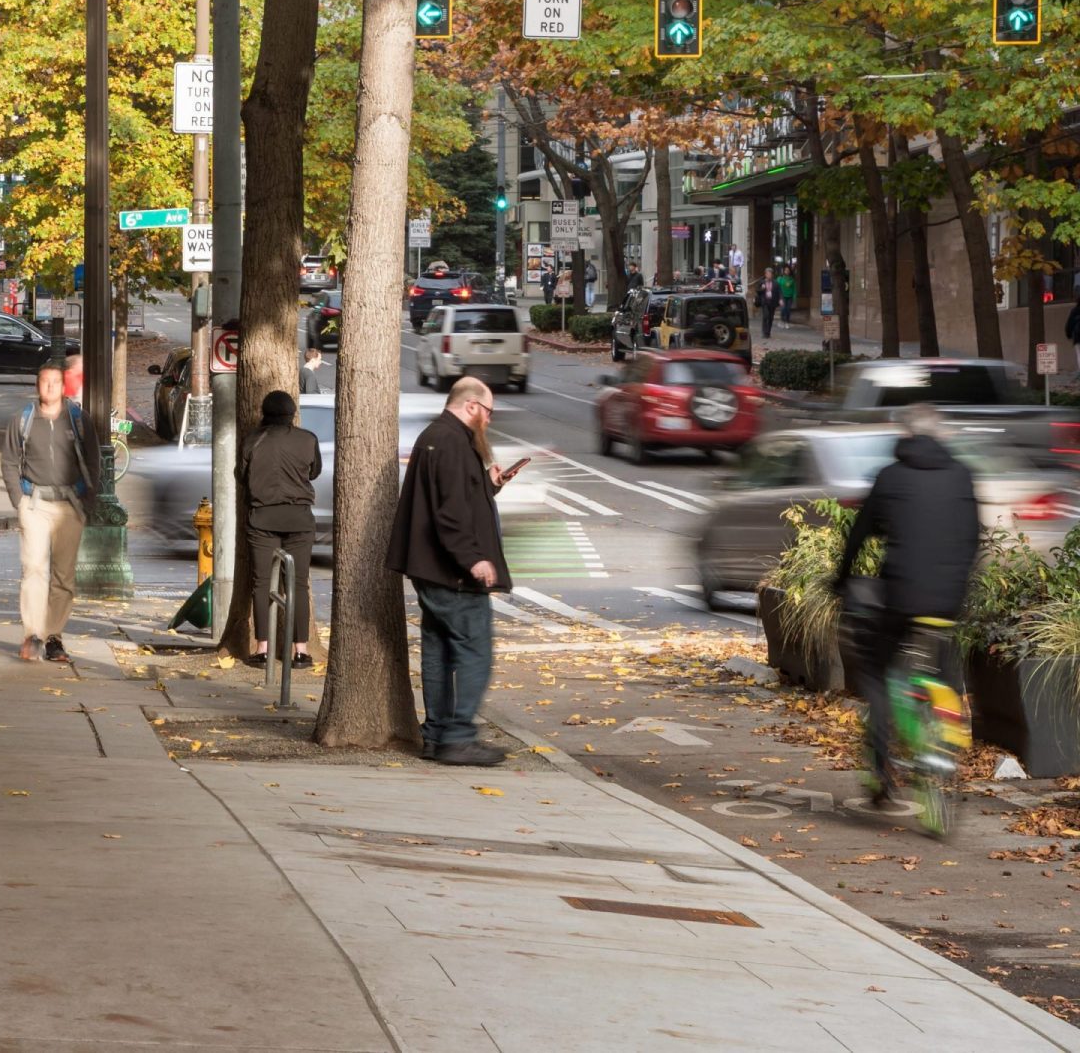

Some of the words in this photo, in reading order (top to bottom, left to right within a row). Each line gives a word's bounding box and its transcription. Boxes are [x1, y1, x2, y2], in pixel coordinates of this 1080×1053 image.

[544, 7, 561, 18] ON
[540, 22, 565, 33] RED
[191, 70, 213, 83] NO
[187, 87, 212, 97] TUR
[194, 101, 211, 112] ON
[191, 116, 213, 127] RED
[552, 218, 577, 226] BUSES
[187, 228, 213, 240] ONE
[187, 242, 213, 252] WAY
